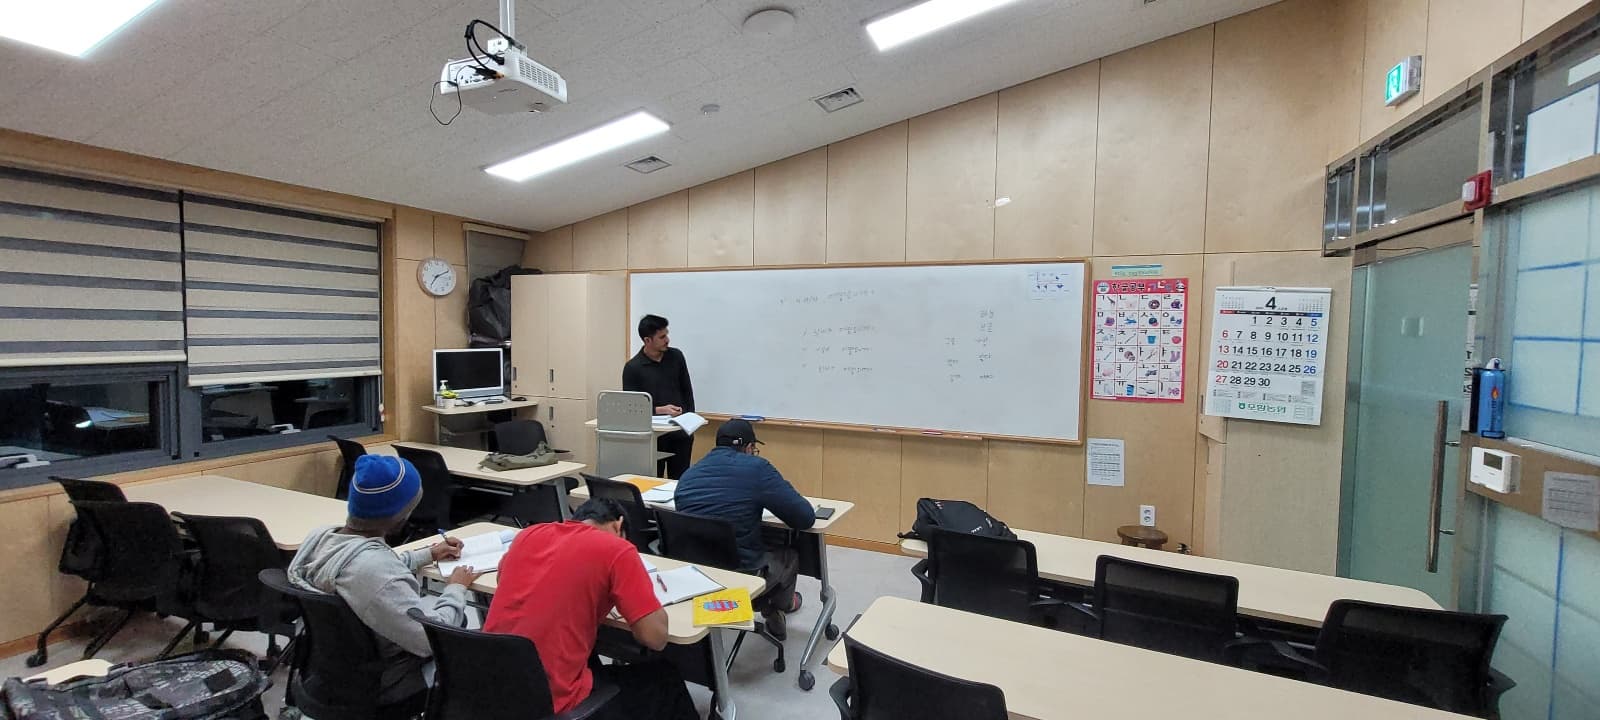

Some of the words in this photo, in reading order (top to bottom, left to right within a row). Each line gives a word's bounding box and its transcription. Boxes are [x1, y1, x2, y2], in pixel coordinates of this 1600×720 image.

[1266, 296, 1276, 310] 4
[1252, 316, 1256, 324] 1
[1266, 316, 1272, 324] 2
[1280, 316, 1288, 326] 3
[1296, 318, 1302, 326] 4
[1310, 318, 1318, 326] 5
[1222, 330, 1228, 338] 6
[1236, 330, 1244, 338] 7
[1250, 332, 1256, 340] 8
[1264, 332, 1272, 340] 9
[1278, 332, 1288, 342] 10
[1292, 334, 1302, 342] 11
[1306, 334, 1318, 342] 12
[1218, 344, 1230, 354] 13
[1232, 346, 1244, 354] 14
[1246, 346, 1258, 354] 15
[1262, 348, 1272, 356] 16
[1276, 348, 1288, 356] 17
[1290, 348, 1302, 358] 18
[1306, 350, 1318, 358] 19
[1216, 360, 1228, 368] 20
[1232, 360, 1242, 370] 21
[1244, 362, 1258, 370] 22
[1258, 362, 1272, 372] 23
[1274, 364, 1286, 372] 24
[1288, 364, 1300, 374] 25
[1304, 366, 1316, 374] 26
[1216, 374, 1228, 384] 27
[1230, 376, 1242, 384] 28
[1244, 376, 1256, 386] 29
[1258, 378, 1270, 386] 30
